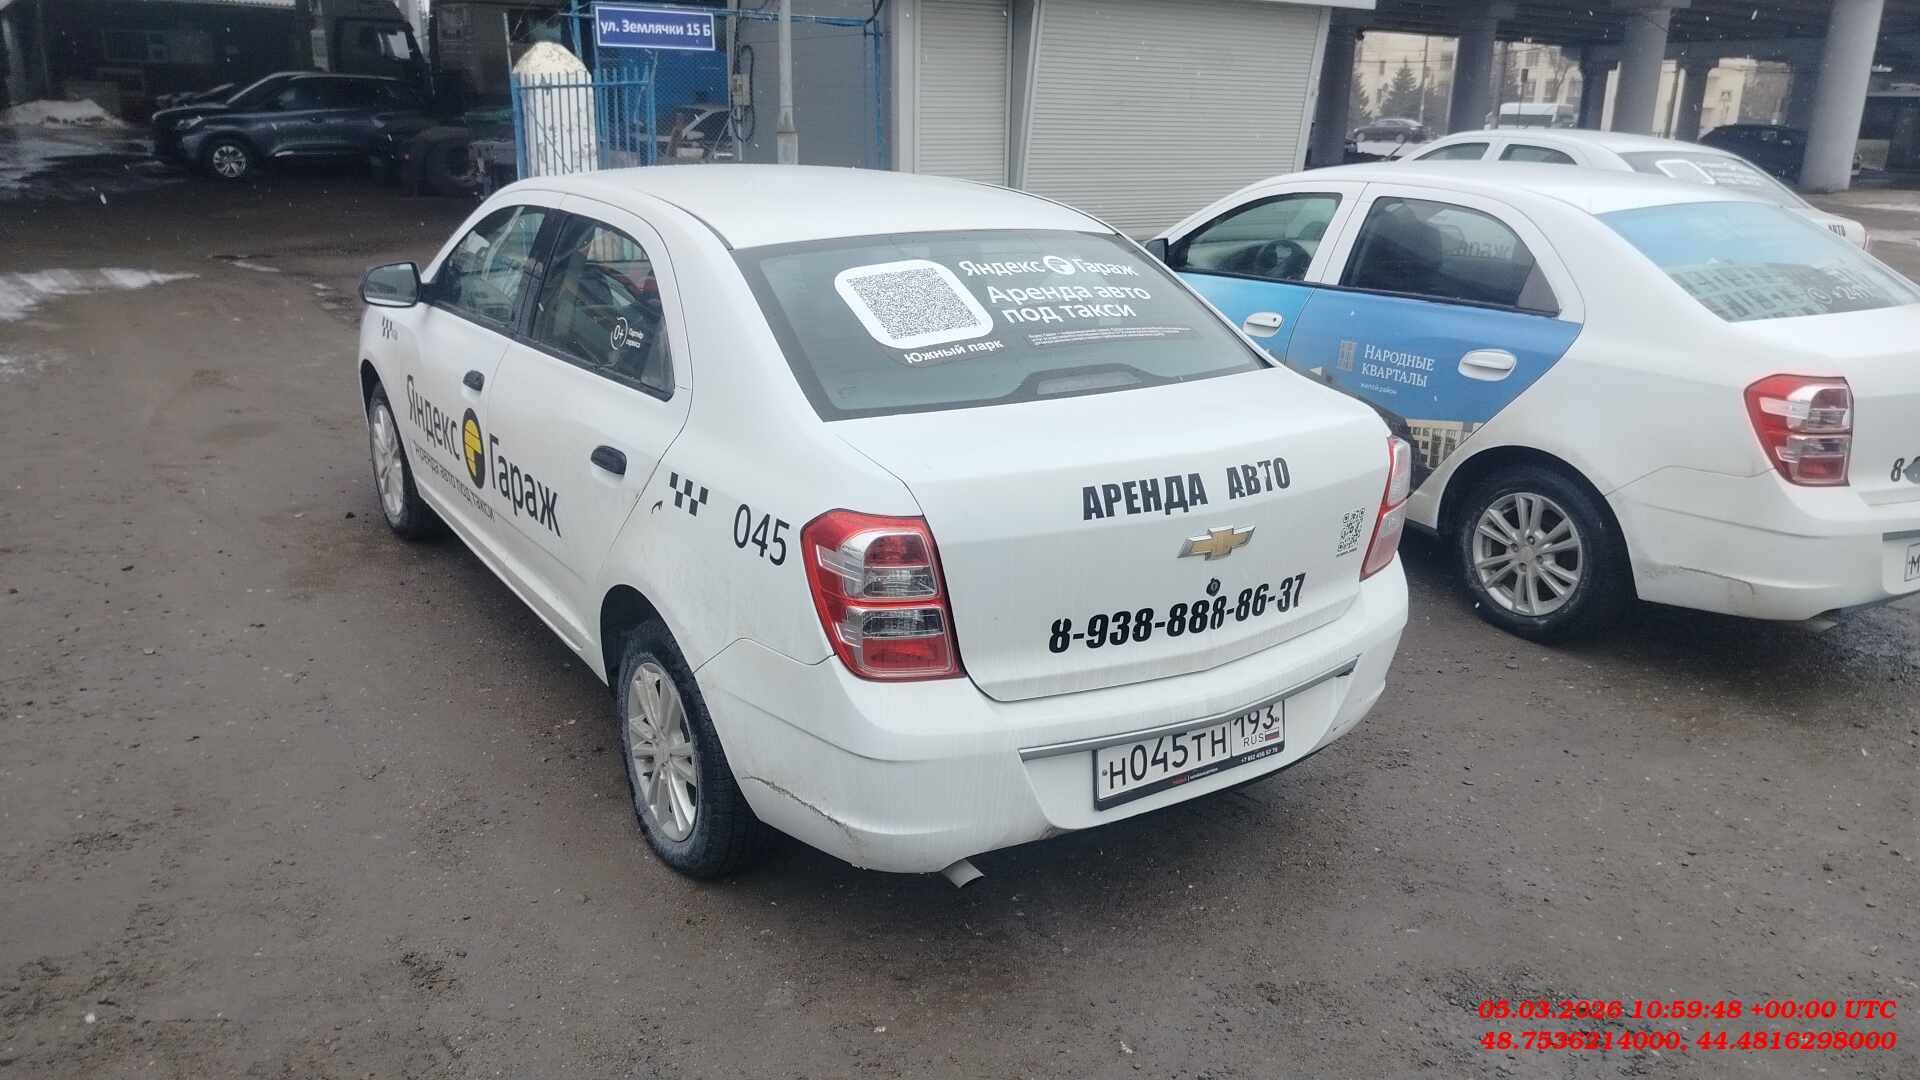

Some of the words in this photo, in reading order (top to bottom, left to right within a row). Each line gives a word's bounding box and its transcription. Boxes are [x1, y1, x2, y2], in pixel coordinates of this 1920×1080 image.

[600, 20, 620, 35] ул.
[622, 19, 684, 35] Землячки
[686, 23, 701, 37] 15
[702, 24, 711, 37] Б
[958, 260, 1046, 277] Яндекс
[1072, 258, 1139, 276] Гараж
[987, 285, 1093, 306] Аренда
[1094, 286, 1152, 300] авто
[1002, 305, 1064, 324] под
[1059, 303, 1137, 319] такси
[903, 344, 966, 364] Южный
[967, 340, 1005, 353] парк
[1364, 344, 1435, 371] НАРОДНЫЕ
[1361, 362, 1427, 388] КВАРТАЛЫ
[406, 374, 460, 461] Яндекс
[489, 433, 562, 538] Гараж
[1082, 472, 1209, 521] АРЕНДА
[1226, 456, 1291, 500] АВТО
[733, 503, 790, 566] 045
[1048, 571, 1306, 654] 8-938-888-86-37
[1233, 703, 1275, 737] 193
[1243, 732, 1265, 748] RUS
[1109, 725, 1227, 790] Н045ТН
